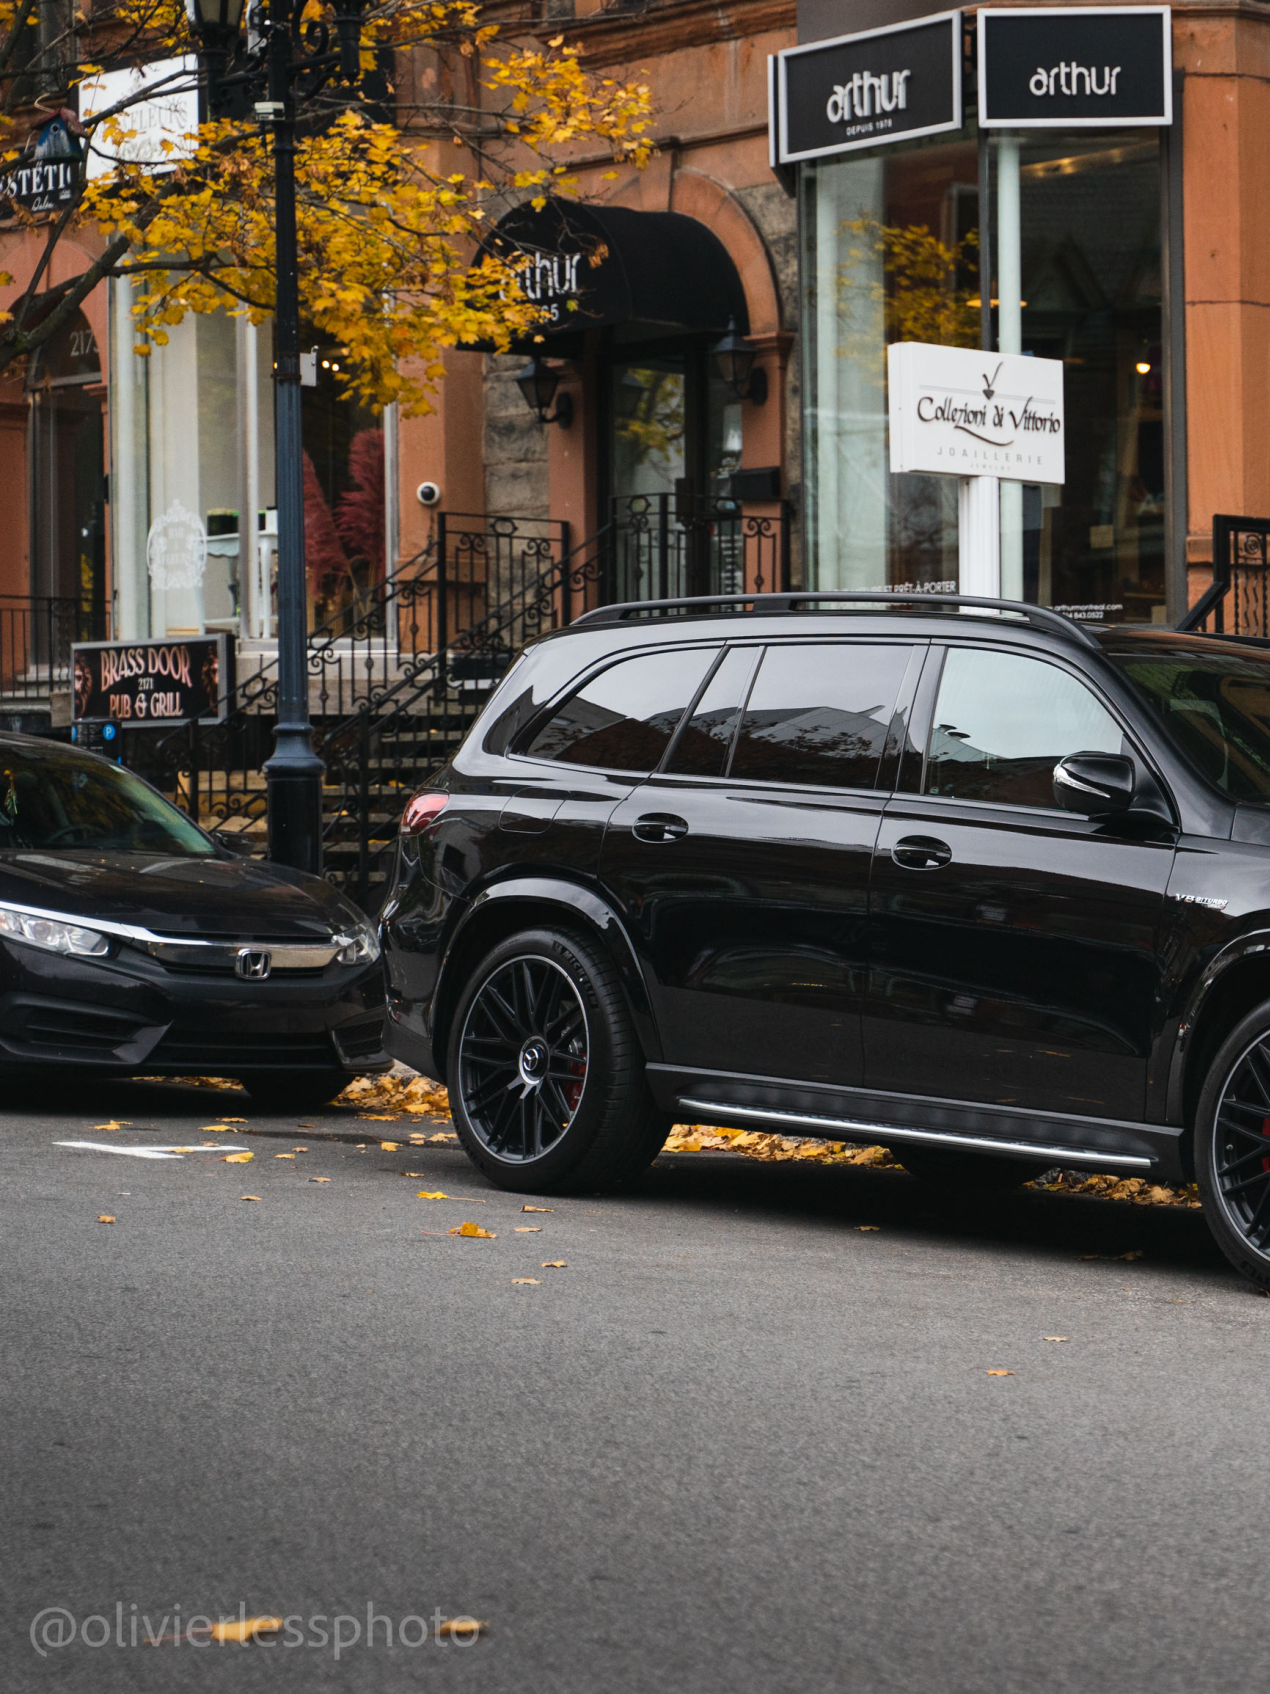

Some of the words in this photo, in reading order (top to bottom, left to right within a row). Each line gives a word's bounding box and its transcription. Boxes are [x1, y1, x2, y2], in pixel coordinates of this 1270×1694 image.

[1029, 61, 1122, 96] arthur
[826, 69, 911, 123] arthur
[846, 122, 873, 136] DEPUIS
[993, 404, 1005, 428] di
[1008, 396, 1061, 433] Vittorio
[937, 447, 1043, 465] JOAILLERIE
[100, 648, 146, 692] BRASS
[148, 645, 193, 688] DOOR
[138, 677, 154, 690] 2171
[110, 694, 132, 718] PUB
[134, 693, 147, 718] &
[150, 692, 184, 717] GRILL
[1175, 893, 1195, 903] V8
